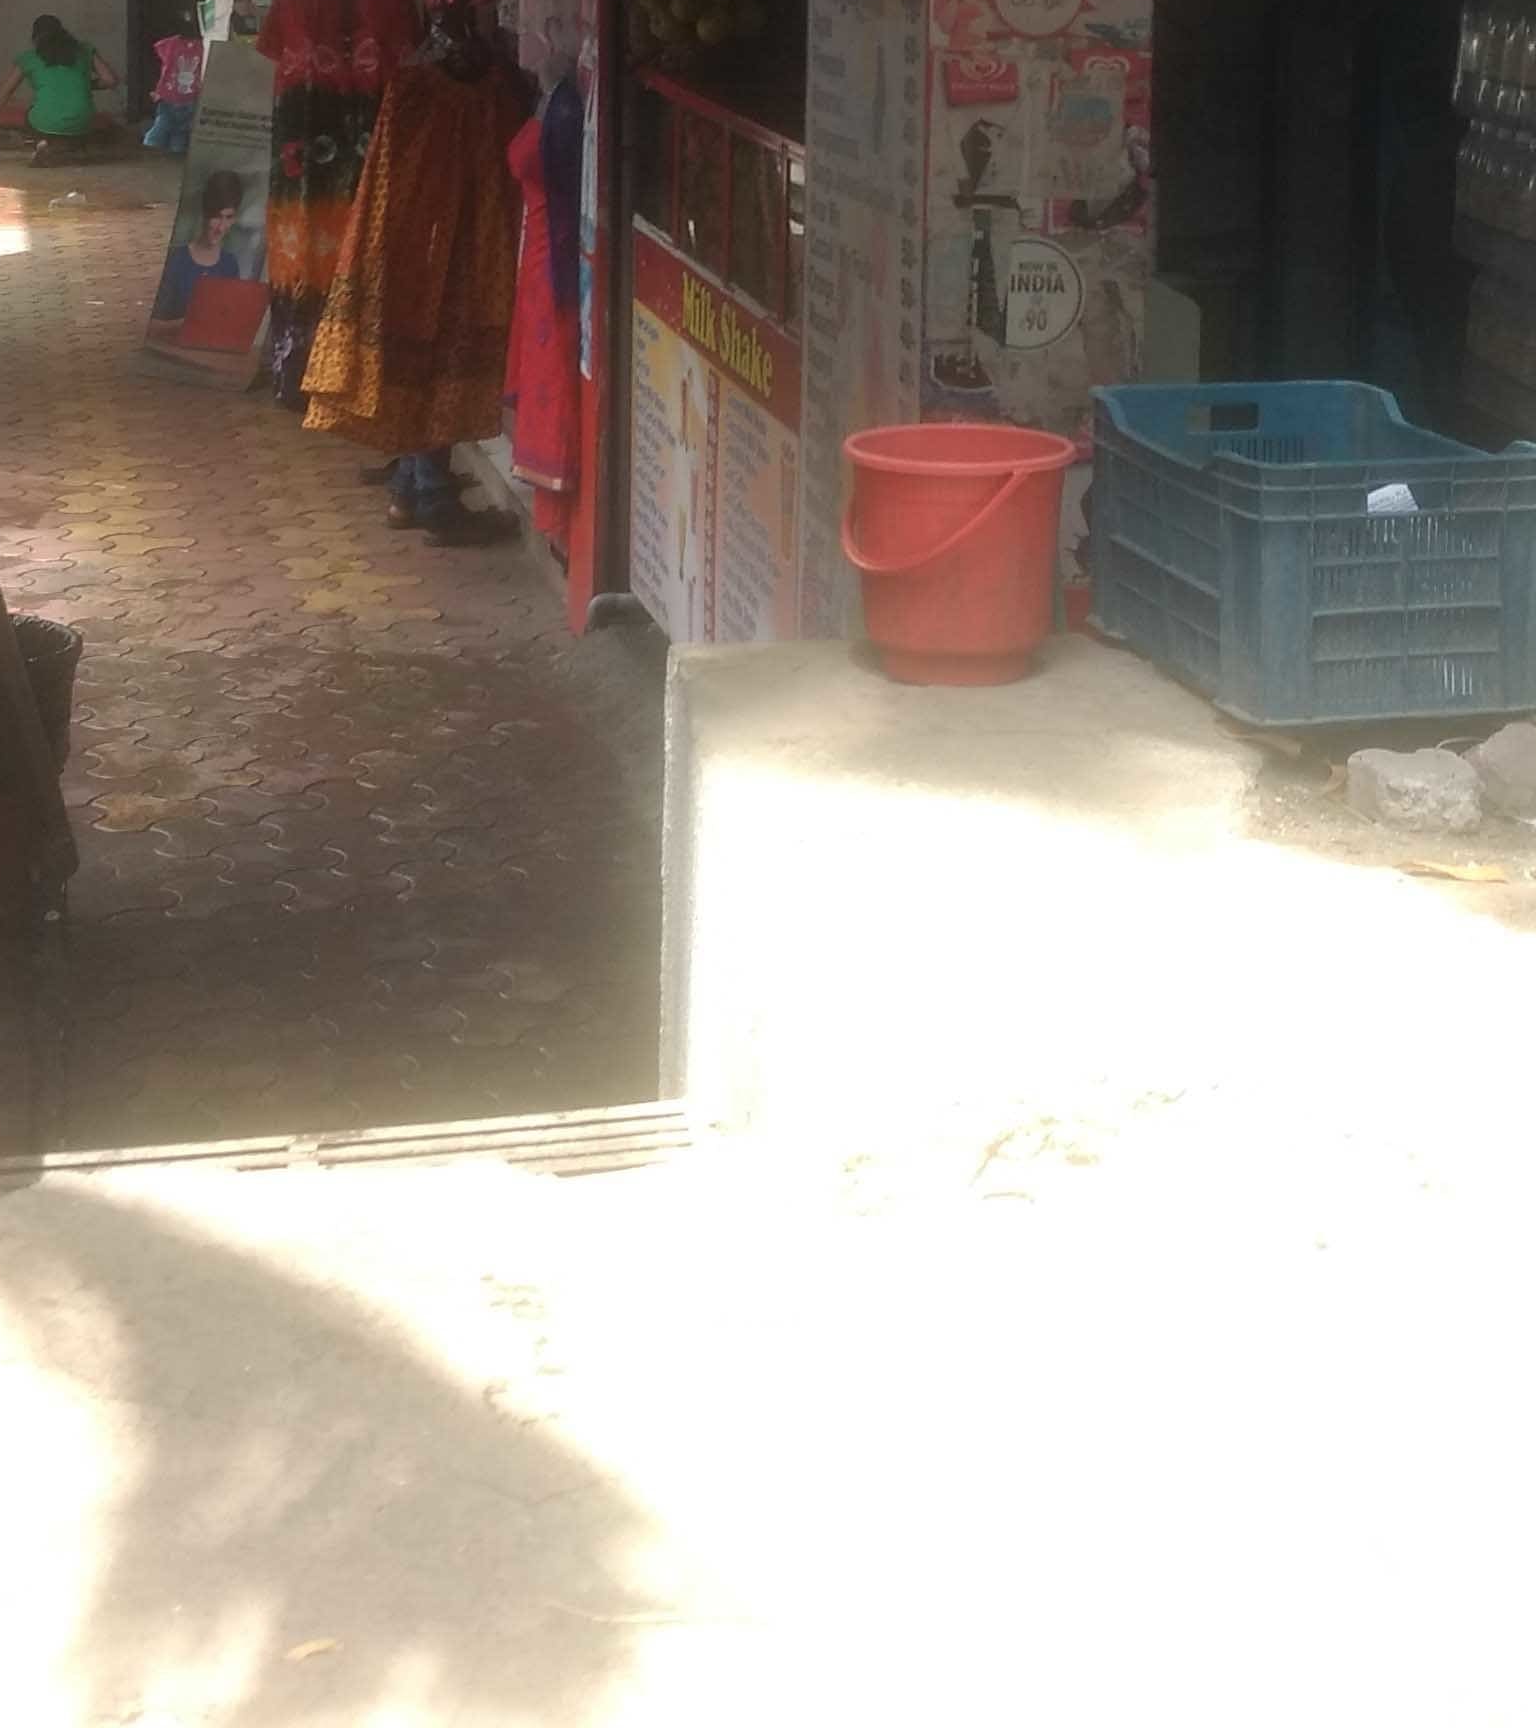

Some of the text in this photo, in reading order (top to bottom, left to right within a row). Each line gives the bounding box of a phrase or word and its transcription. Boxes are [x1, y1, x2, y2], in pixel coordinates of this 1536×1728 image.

[1009, 273, 1066, 294] INDIA
[682, 271, 774, 399] Milk Shake
